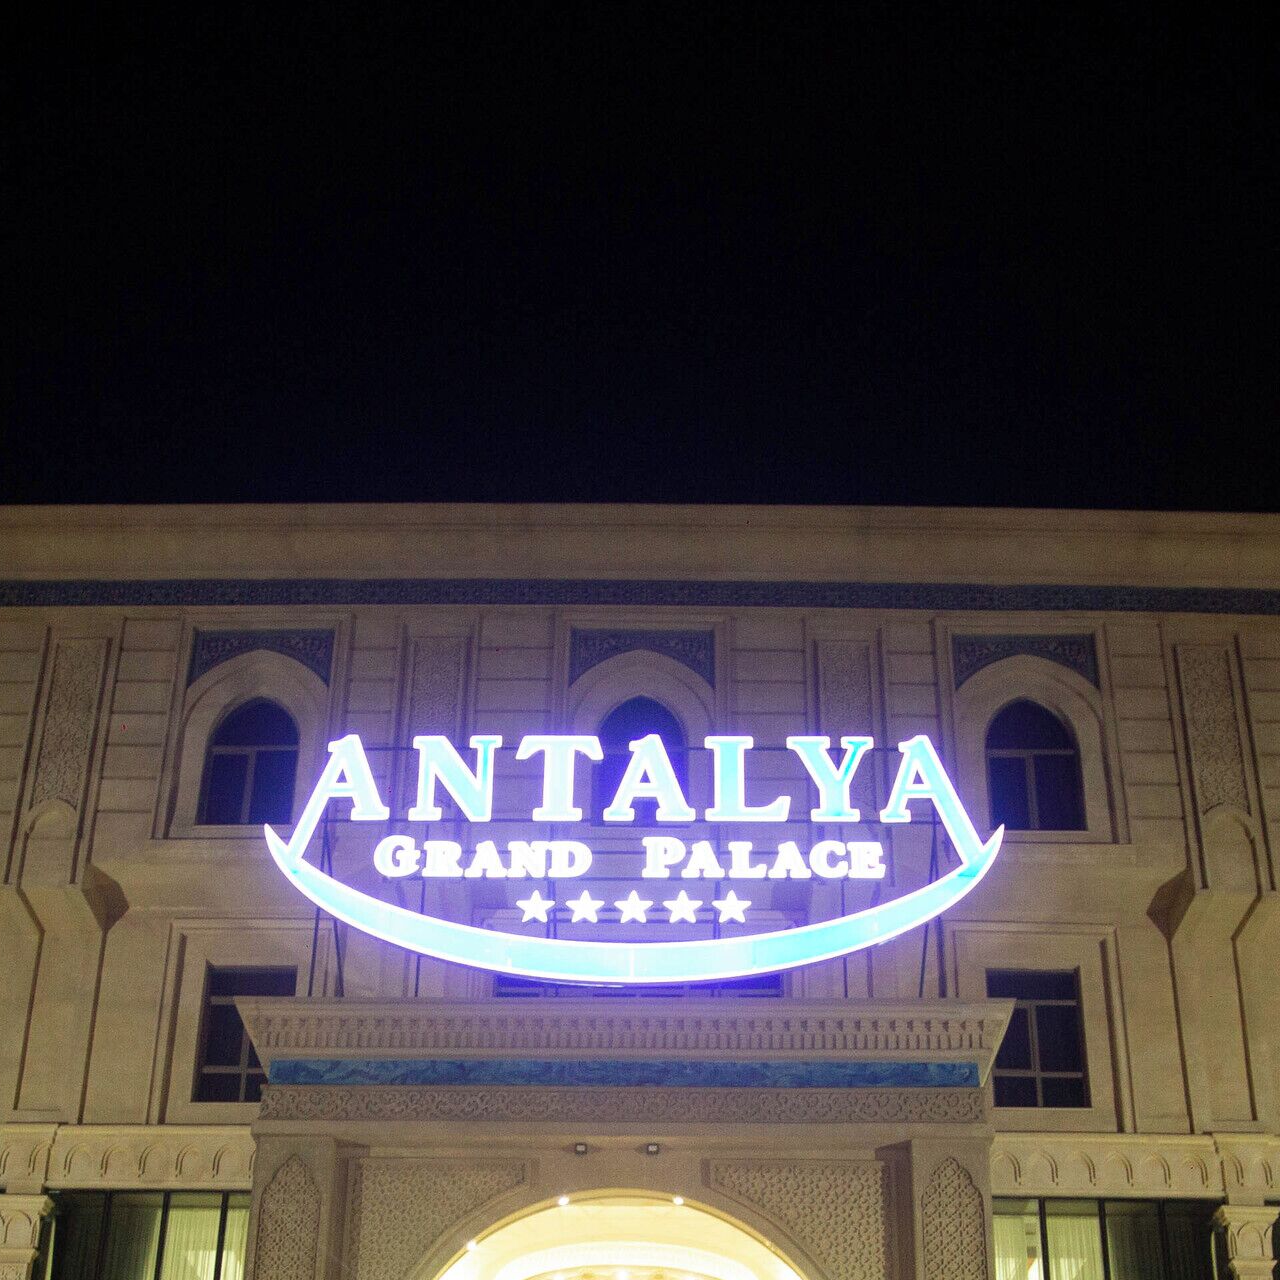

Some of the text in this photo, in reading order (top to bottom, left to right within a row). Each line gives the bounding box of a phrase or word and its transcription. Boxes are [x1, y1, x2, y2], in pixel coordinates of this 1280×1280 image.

[287, 733, 986, 863] ANTALYA
[373, 834, 886, 879] GRAND PALACE
